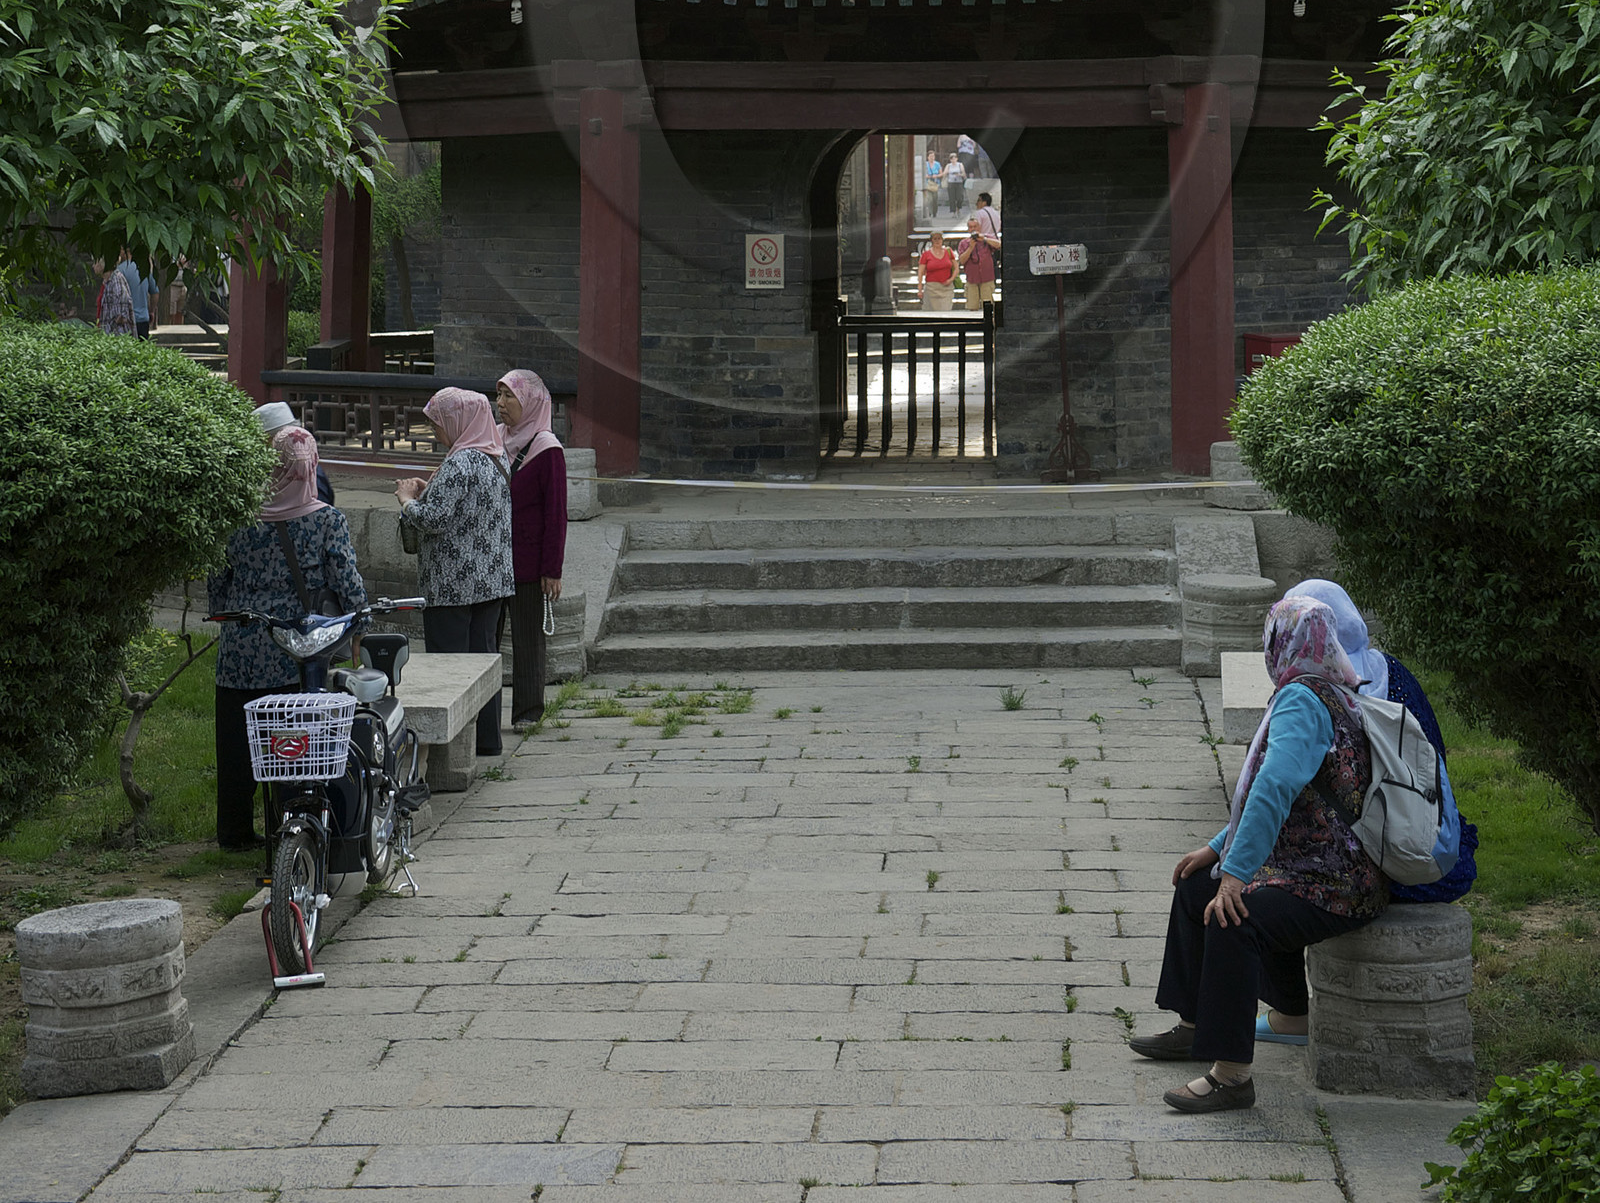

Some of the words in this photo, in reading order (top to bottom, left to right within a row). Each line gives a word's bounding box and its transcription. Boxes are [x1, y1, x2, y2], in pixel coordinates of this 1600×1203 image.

[1035, 248, 1080, 264] 省心楼
[749, 268, 781, 278] 请勿吸烟
